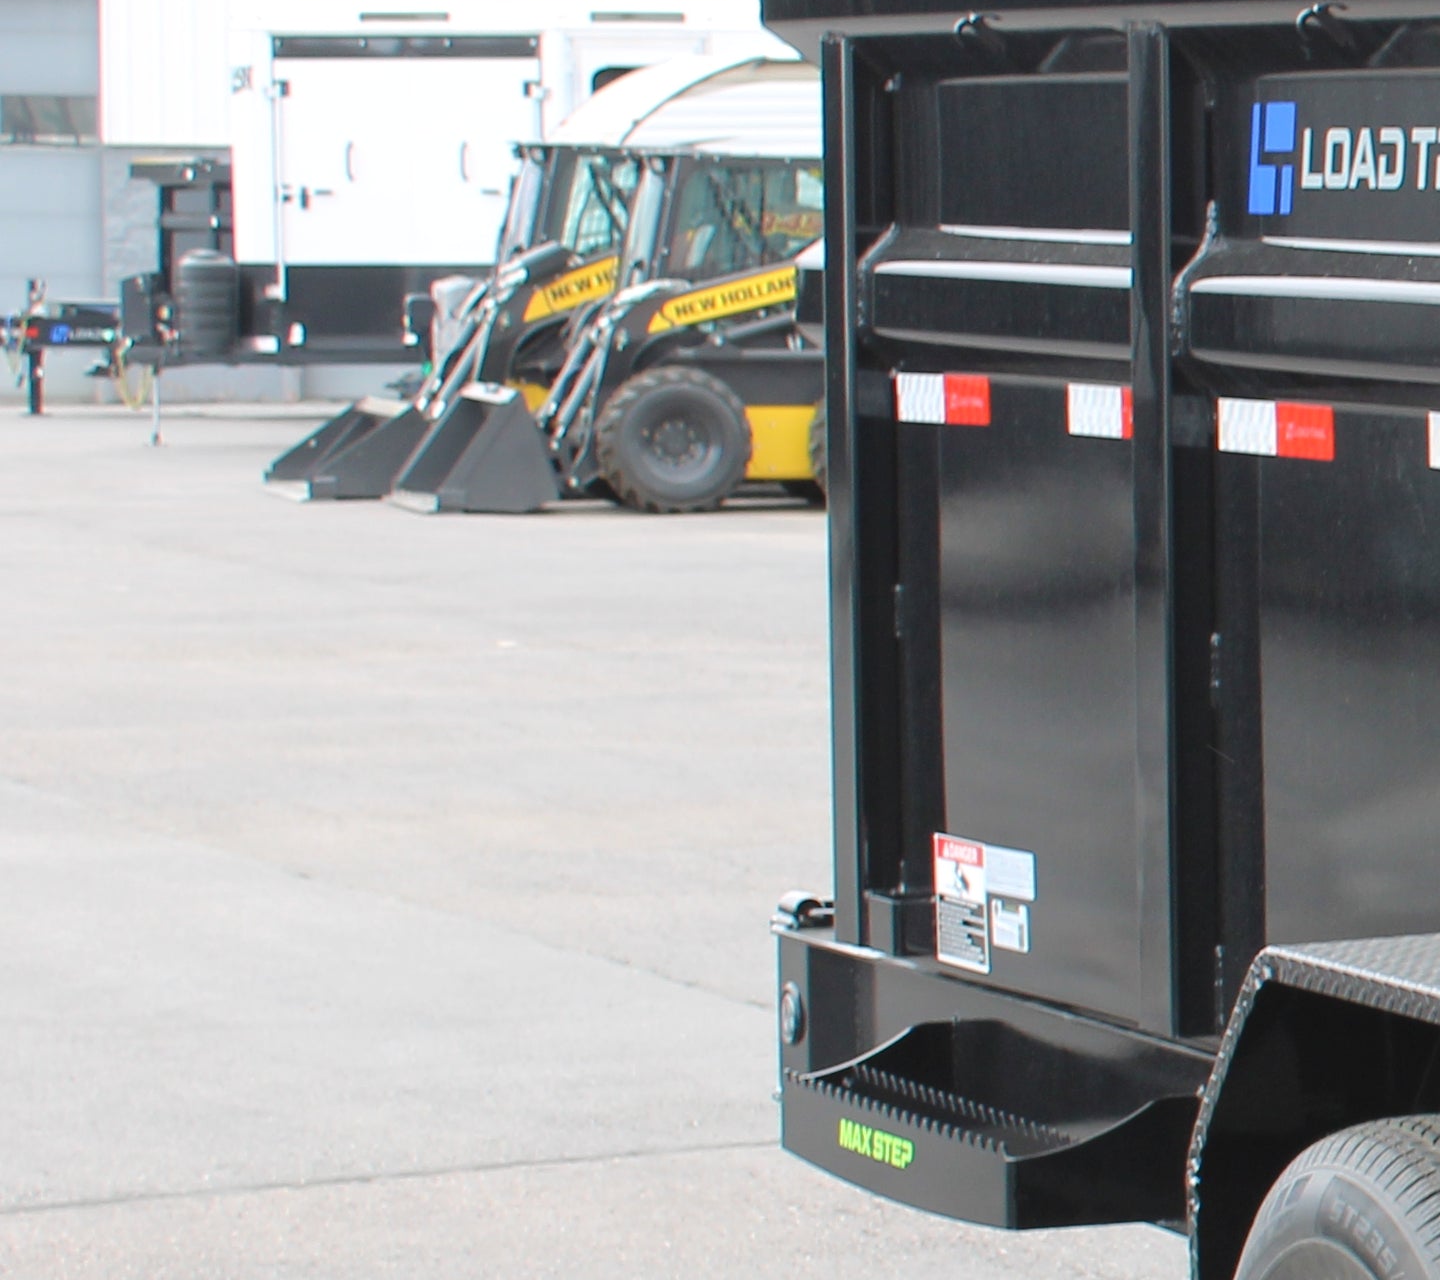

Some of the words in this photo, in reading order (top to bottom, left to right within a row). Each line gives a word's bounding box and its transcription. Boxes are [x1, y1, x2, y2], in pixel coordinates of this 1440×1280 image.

[1301, 127, 1405, 190] LOAD
[550, 278, 592, 303] NEW
[673, 297, 717, 319] NEW
[720, 277, 797, 305] HOLLAN
[839, 1117, 873, 1157] MAX
[872, 1129, 915, 1169] STEP
